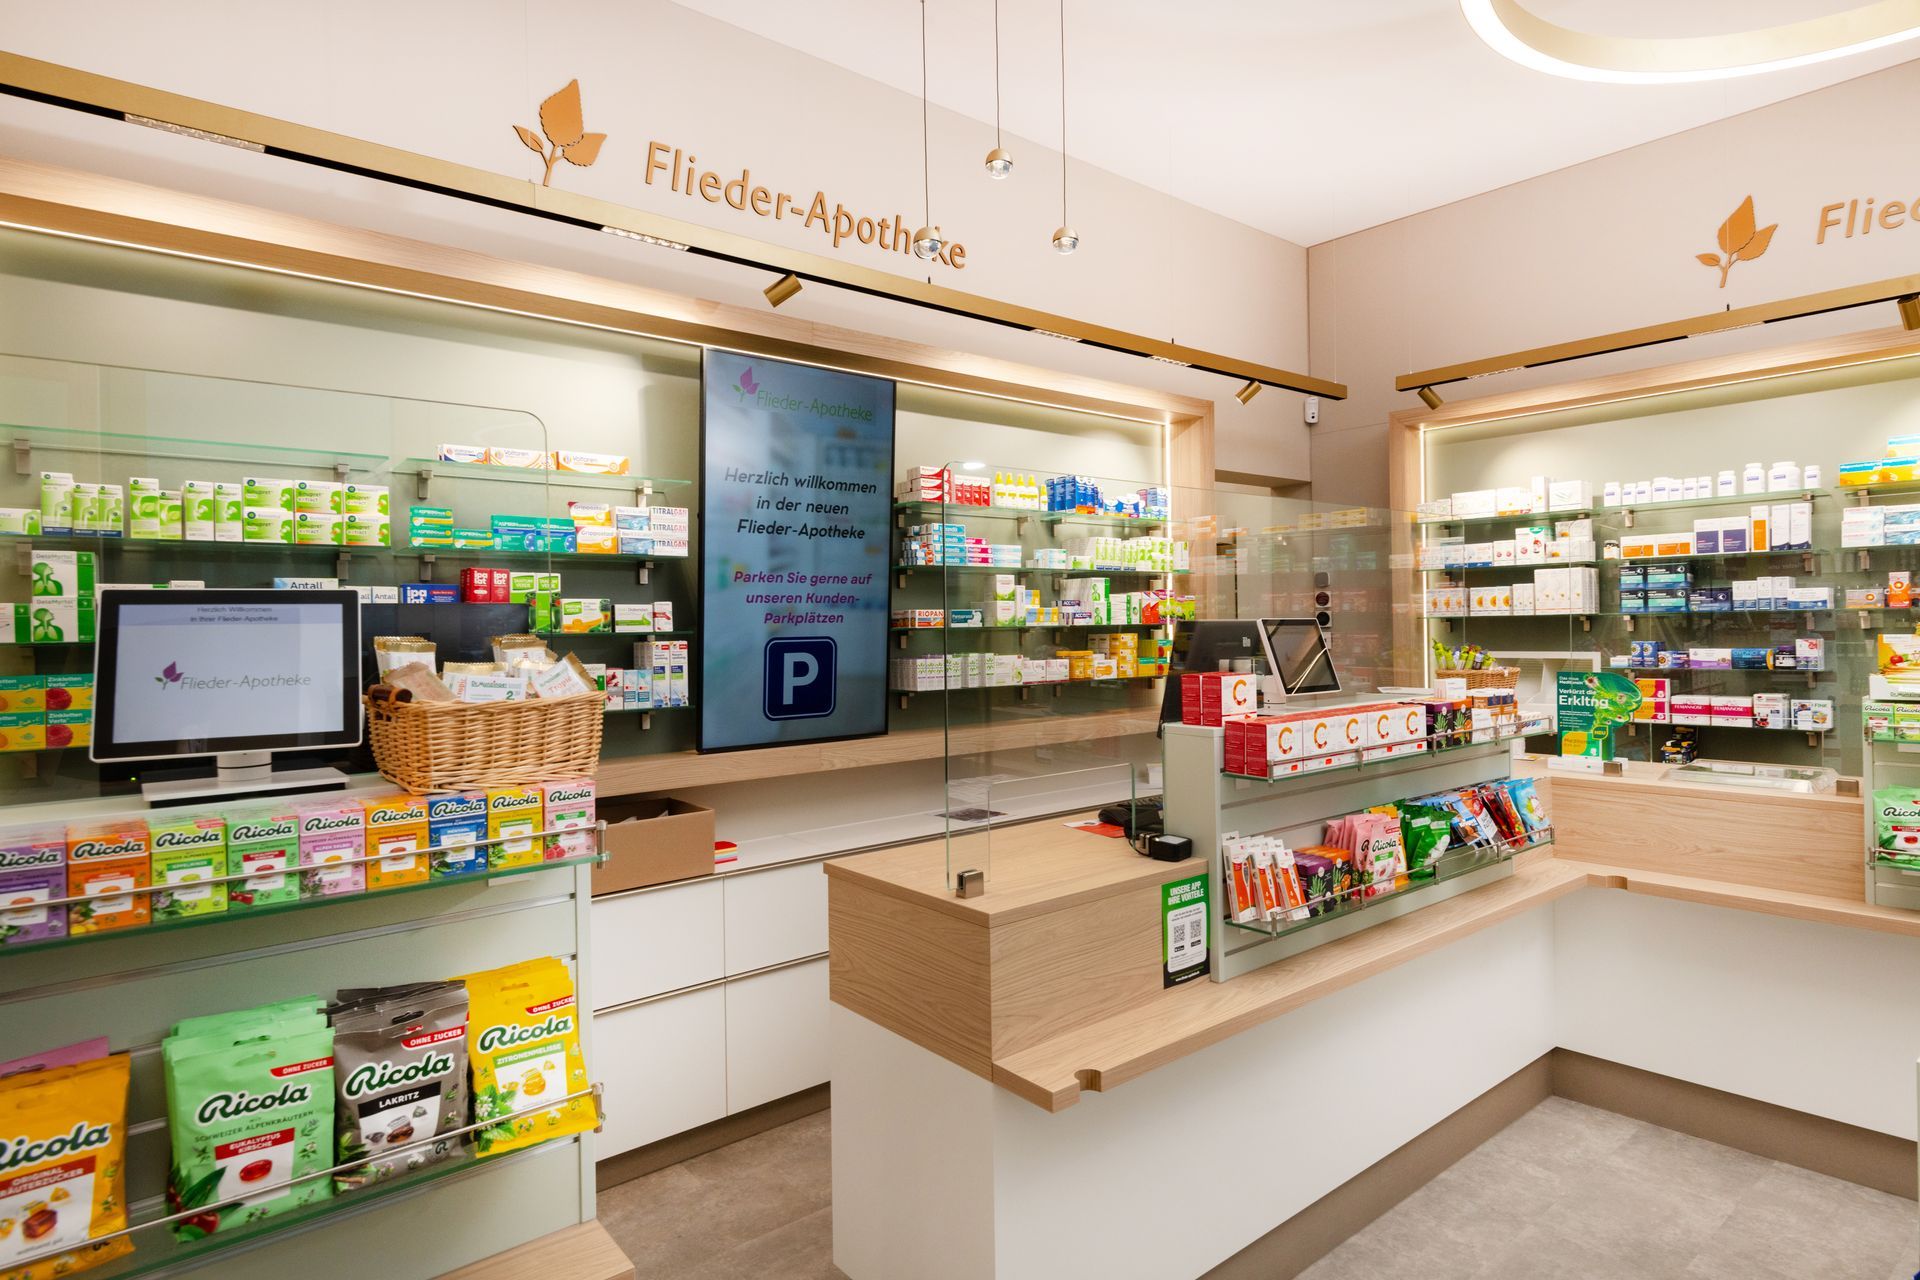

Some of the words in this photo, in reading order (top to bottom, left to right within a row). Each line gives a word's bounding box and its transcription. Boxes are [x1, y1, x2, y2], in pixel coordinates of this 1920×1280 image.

[646, 141, 966, 269] Flieder-Apothke
[756, 391, 873, 422] Flieder-Apotheke
[724, 467, 789, 487] Herzlich
[794, 473, 877, 494] willkommen
[756, 496, 770, 510] in
[775, 497, 801, 512] der
[806, 503, 849, 515] neuen
[737, 519, 865, 540] Flieder-Apotheke
[733, 570, 784, 584] Parken
[786, 571, 807, 585] Sie
[810, 574, 847, 588] gerne
[851, 573, 872, 585] auf
[746, 592, 802, 605] unseren
[806, 592, 860, 605] Kunden-
[764, 611, 844, 626] Parkplätzen
[180, 674, 312, 691] Flieder-Apotheke
[783, 651, 818, 705] P
[1233, 679, 1247, 706] C
[1559, 695, 1609, 709] Erkltng
[1345, 718, 1359, 744] C
[1376, 714, 1389, 740] C
[1406, 710, 1418, 735] C
[1278, 726, 1293, 755] C
[1314, 722, 1328, 749] C
[492, 795, 538, 809] Ricola
[549, 789, 592, 803] Ricola
[372, 808, 424, 823] Ricola
[433, 801, 484, 816] Ricola
[233, 824, 293, 840] Ricola
[305, 816, 360, 831] Ricola
[156, 831, 220, 847] Ricola
[1372, 838, 1397, 853] Ricola
[74, 840, 144, 858] Ricola
[1170, 885, 1191, 897] UNSERE
[532, 1004, 551, 1013] OHNE
[410, 1036, 432, 1046] OHNE
[434, 1029, 462, 1041] ZUCKER
[480, 1017, 572, 1051] Ricola
[282, 1064, 302, 1075] OHNE
[303, 1060, 328, 1071] ZUCKER
[346, 1054, 451, 1096] Ricola
[198, 1084, 309, 1123] Ricola
[379, 1091, 420, 1108] LAKRITZ
[195, 1126, 243, 1143] SCHWEIZER
[245, 1110, 314, 1131] ALPENKRÄUTERN
[229, 1132, 281, 1150] EUKALYPTUS
[11, 1167, 64, 1186] ORIGINAL
